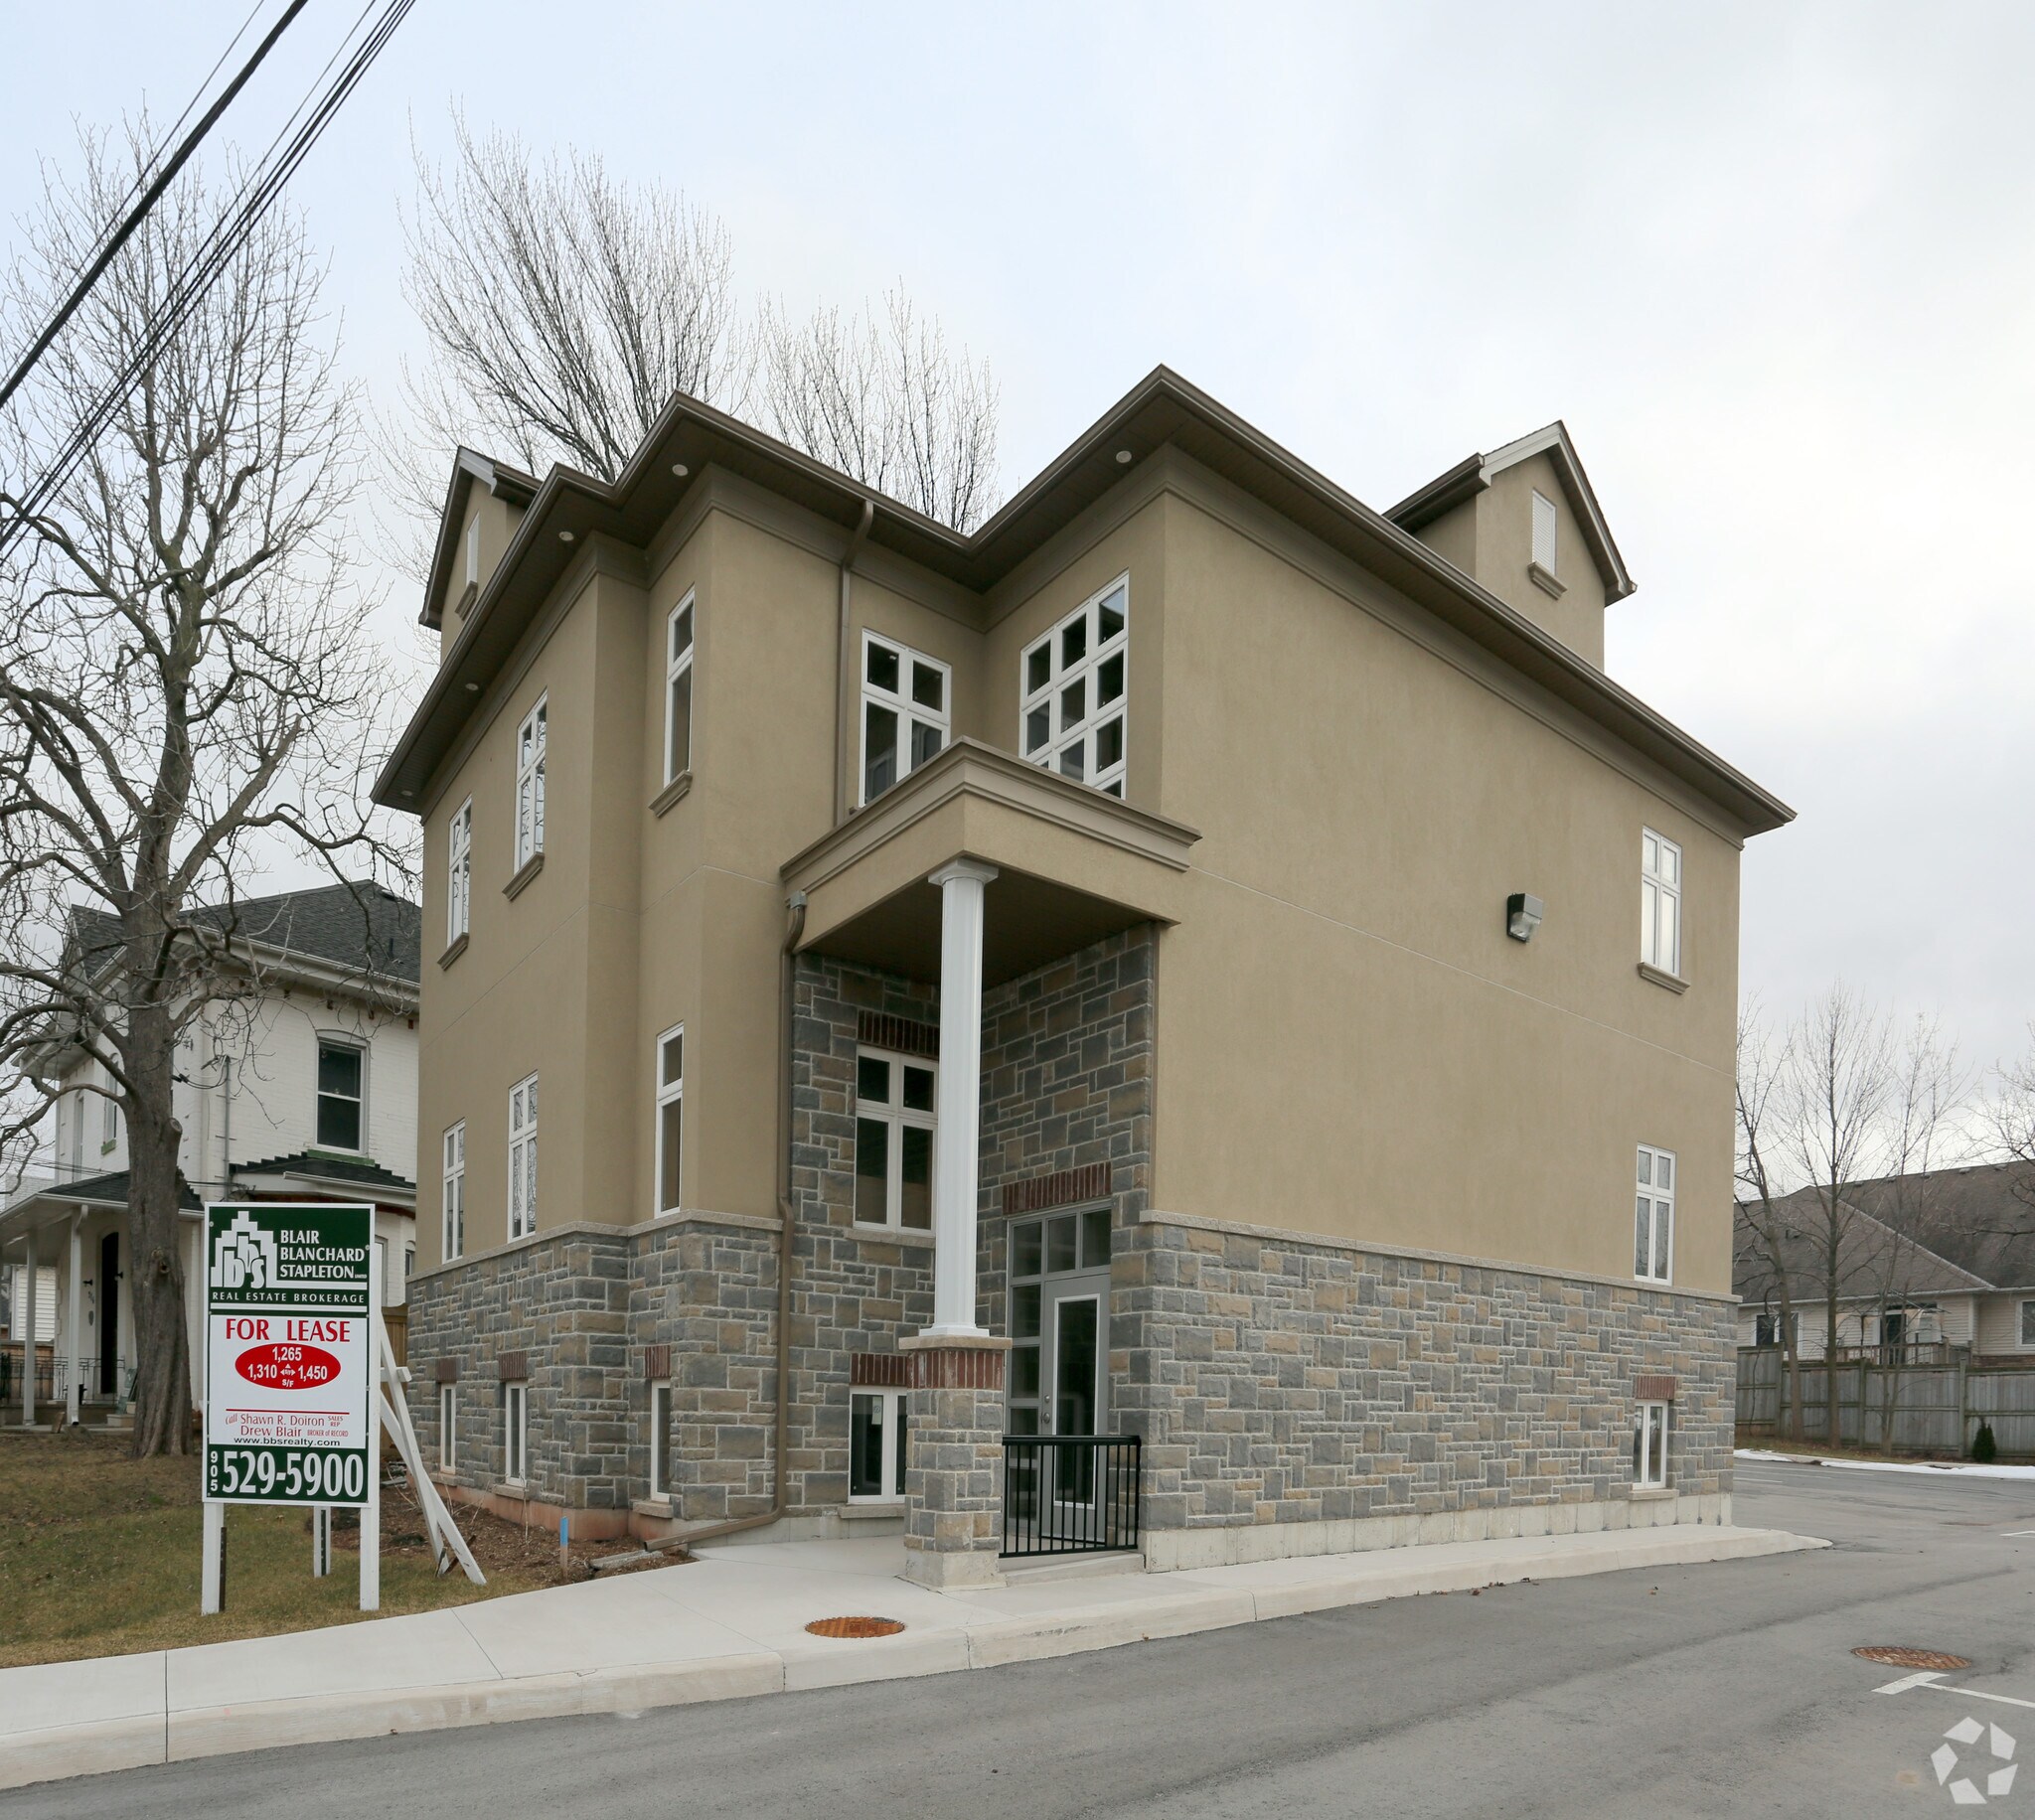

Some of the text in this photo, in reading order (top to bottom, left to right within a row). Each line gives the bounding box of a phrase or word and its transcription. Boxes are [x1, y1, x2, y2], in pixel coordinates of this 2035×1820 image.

[280, 1229, 320, 1244] BLAIR
[280, 1247, 365, 1262] BLANCHARD
[279, 1264, 355, 1279] STAPLETON
[212, 1291, 365, 1303] REAL ESTATE BROKERAGE
[226, 1318, 351, 1342] FOR LEASE
[272, 1346, 302, 1363] 1,265
[247, 1363, 277, 1381] 1,310
[298, 1365, 328, 1382] 1,450
[281, 1379, 294, 1388] S/F
[240, 1413, 274, 1425] Shawn
[277, 1415, 287, 1426] R.
[290, 1415, 325, 1427] Doiron
[240, 1425, 272, 1436] Drew
[276, 1426, 302, 1438] Blair
[234, 1437, 341, 1447] www.bbsrealty.com
[222, 1450, 364, 1497] 529-5900
